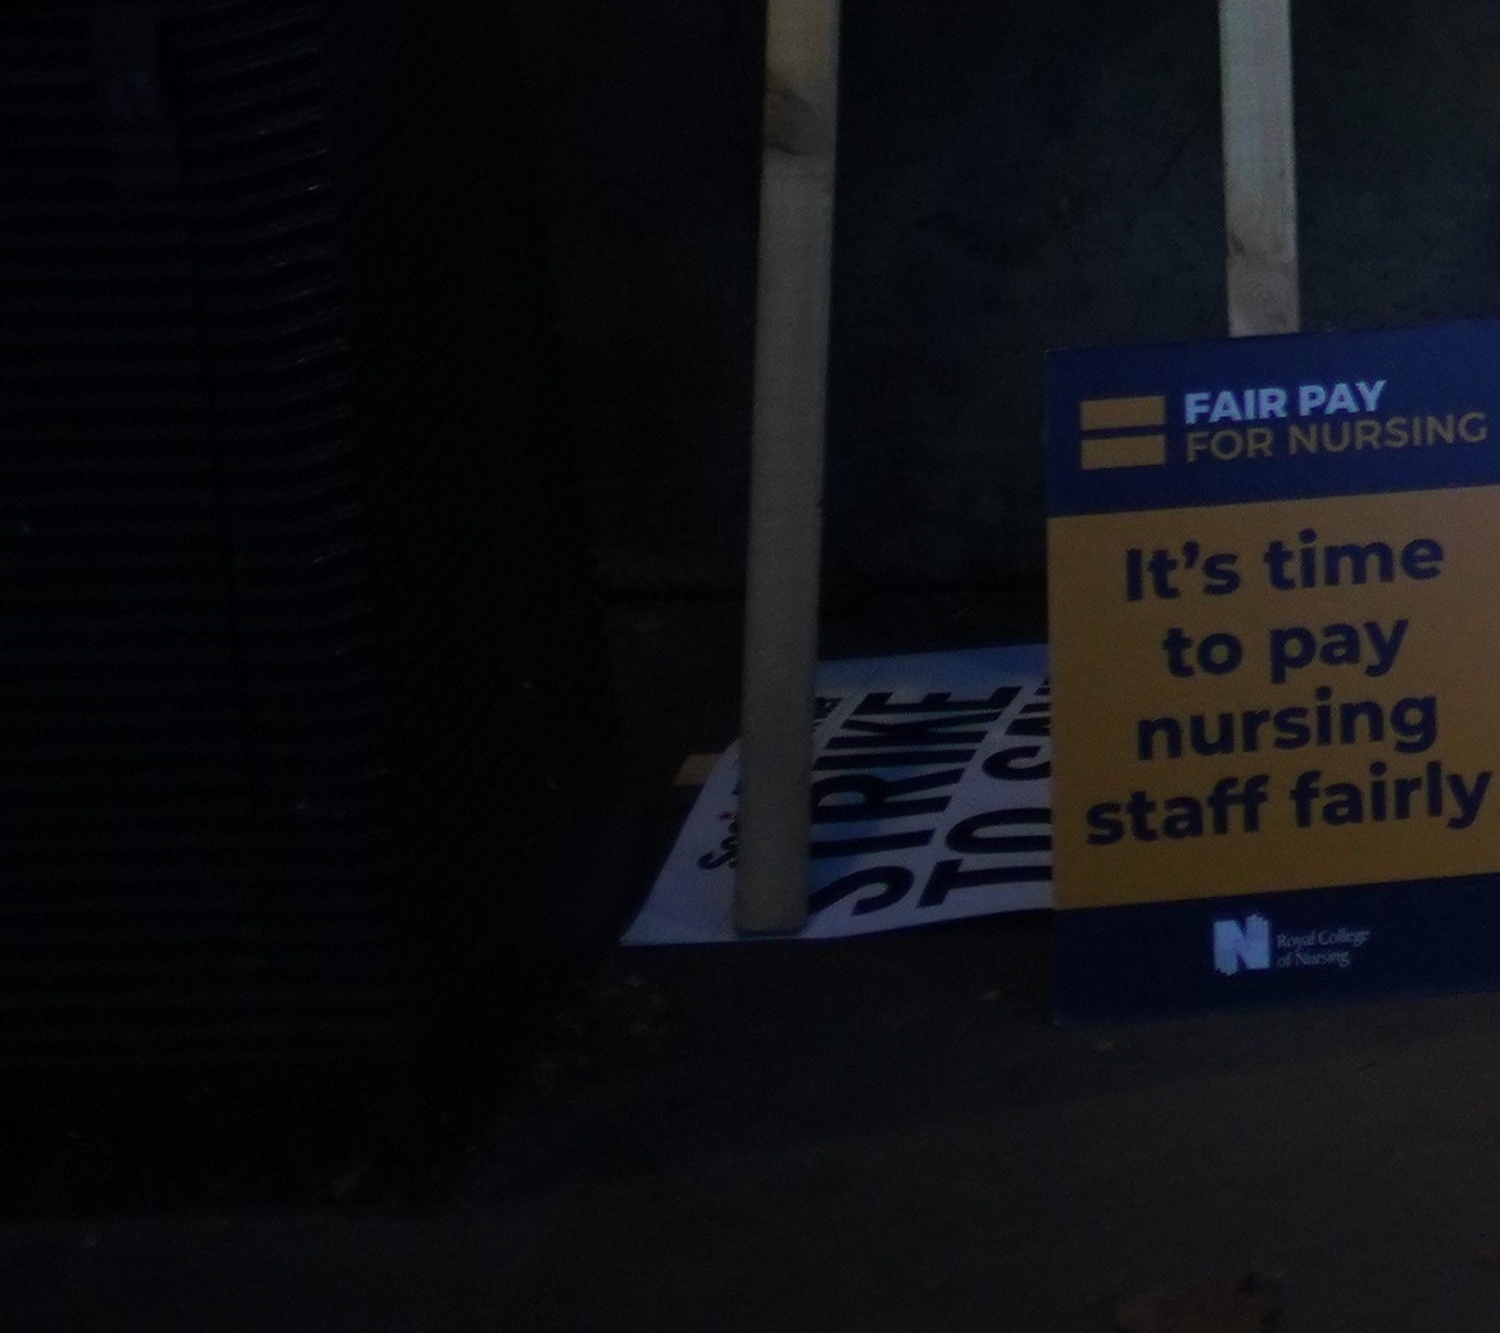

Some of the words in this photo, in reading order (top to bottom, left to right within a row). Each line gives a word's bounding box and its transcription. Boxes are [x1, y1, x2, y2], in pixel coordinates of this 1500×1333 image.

[1185, 388, 1288, 425] FAIR
[1300, 379, 1387, 416] PAY
[1186, 426, 1273, 462] FOR
[1289, 412, 1487, 455] NURSING
[1264, 528, 1444, 590] time
[1163, 628, 1243, 678] to
[1270, 620, 1409, 684] pay
[1137, 686, 1438, 760] nursing
[1086, 775, 1269, 845] staff
[1290, 761, 1493, 829] fairly
